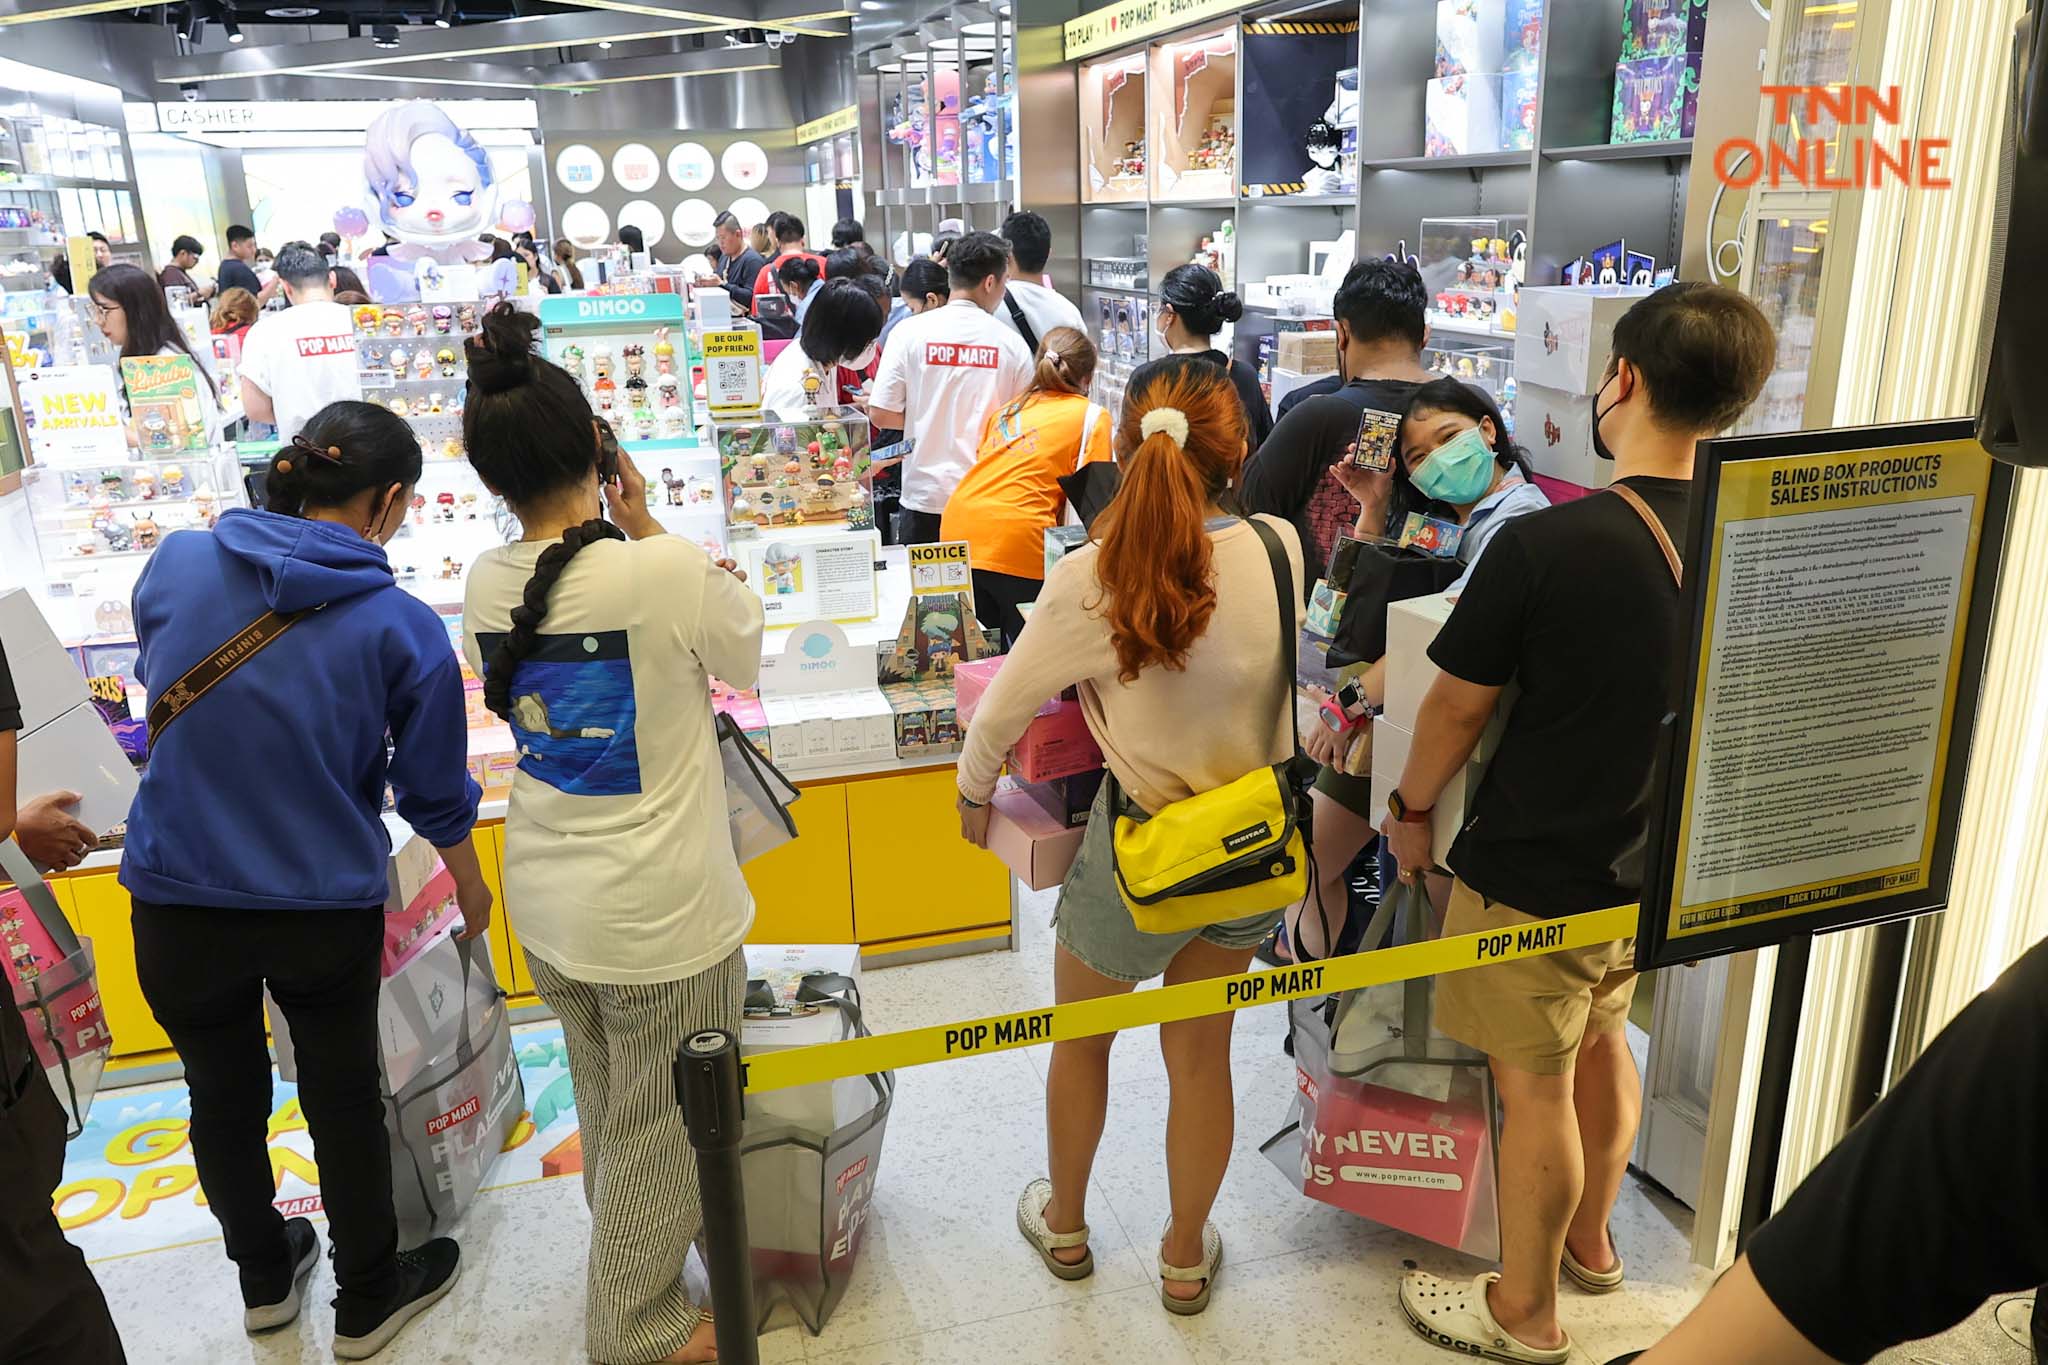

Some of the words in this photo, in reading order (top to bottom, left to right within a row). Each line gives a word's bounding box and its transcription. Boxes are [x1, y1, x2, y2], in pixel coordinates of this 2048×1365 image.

[1078, 23, 1093, 44] PLAY
[1120, 11, 1135, 31] POP
[1136, 2, 1158, 26] MART
[167, 108, 255, 125] CASHIER
[578, 299, 646, 317] DIMOO
[301, 338, 326, 355] POP
[725, 344, 755, 352] FRIEND
[727, 334, 743, 342] OUR
[928, 345, 955, 363] POP
[958, 347, 996, 366] MART
[42, 391, 107, 414] NEW
[42, 415, 119, 430] ARRIVALS
[1771, 466, 1820, 487] BLIND
[1824, 463, 1856, 481] BOX
[1859, 454, 1941, 478] PRODUCTS
[1770, 486, 1819, 505] SALES
[1823, 473, 1938, 500] INSTRUCTIONS
[912, 546, 967, 561] NOTICE
[215, 630, 264, 669] BINFUNI
[800, 661, 836, 670] DIMOO
[1229, 827, 1265, 846] FREITAG
[1681, 914, 1698, 925] FUN
[1698, 908, 1720, 922] NEVER
[1721, 904, 1741, 918] ENDS
[1788, 892, 1809, 905] BACK
[1810, 890, 1820, 901] TO
[1821, 886, 1839, 900] PLAY
[1885, 876, 1898, 887] POP
[1899, 871, 1918, 883] MART
[945, 1026, 988, 1054] POP
[994, 1013, 1053, 1046] MART
[1226, 979, 1266, 1005] POP
[1271, 966, 1325, 997] MART
[1477, 934, 1512, 960] POP
[1517, 923, 1567, 952] MART
[71, 1003, 87, 1022] POP
[428, 1115, 449, 1133] POP
[451, 1098, 478, 1121] MART
[1334, 1129, 1458, 1161] NEVER
[846, 1158, 866, 1181] MART
[1356, 1170, 1446, 1185] www.popmart.com
[273, 1195, 323, 1216] MART
[1415, 1319, 1481, 1355] crocs
